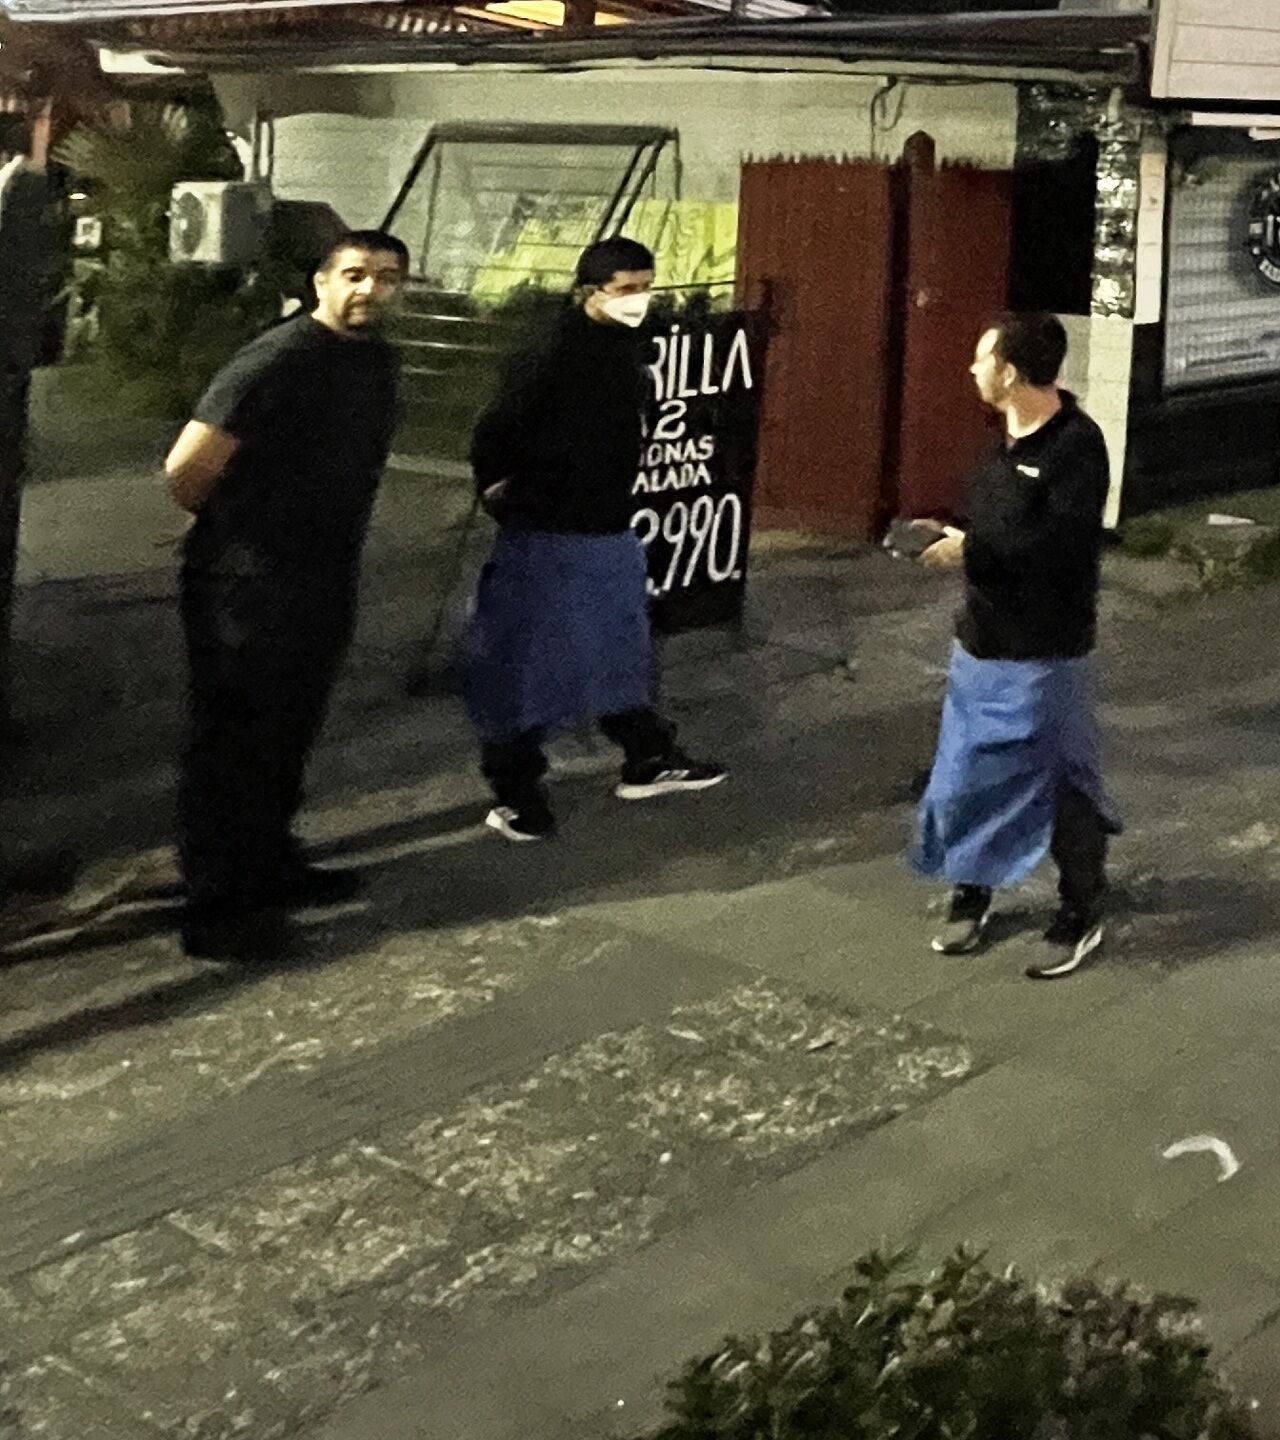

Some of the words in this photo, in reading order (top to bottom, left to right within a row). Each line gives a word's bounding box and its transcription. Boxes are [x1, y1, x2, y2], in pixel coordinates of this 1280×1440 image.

[649, 324, 752, 401] RILLA
[653, 400, 687, 439] 2
[640, 435, 715, 467] ONAS
[631, 462, 712, 495] ALADA
